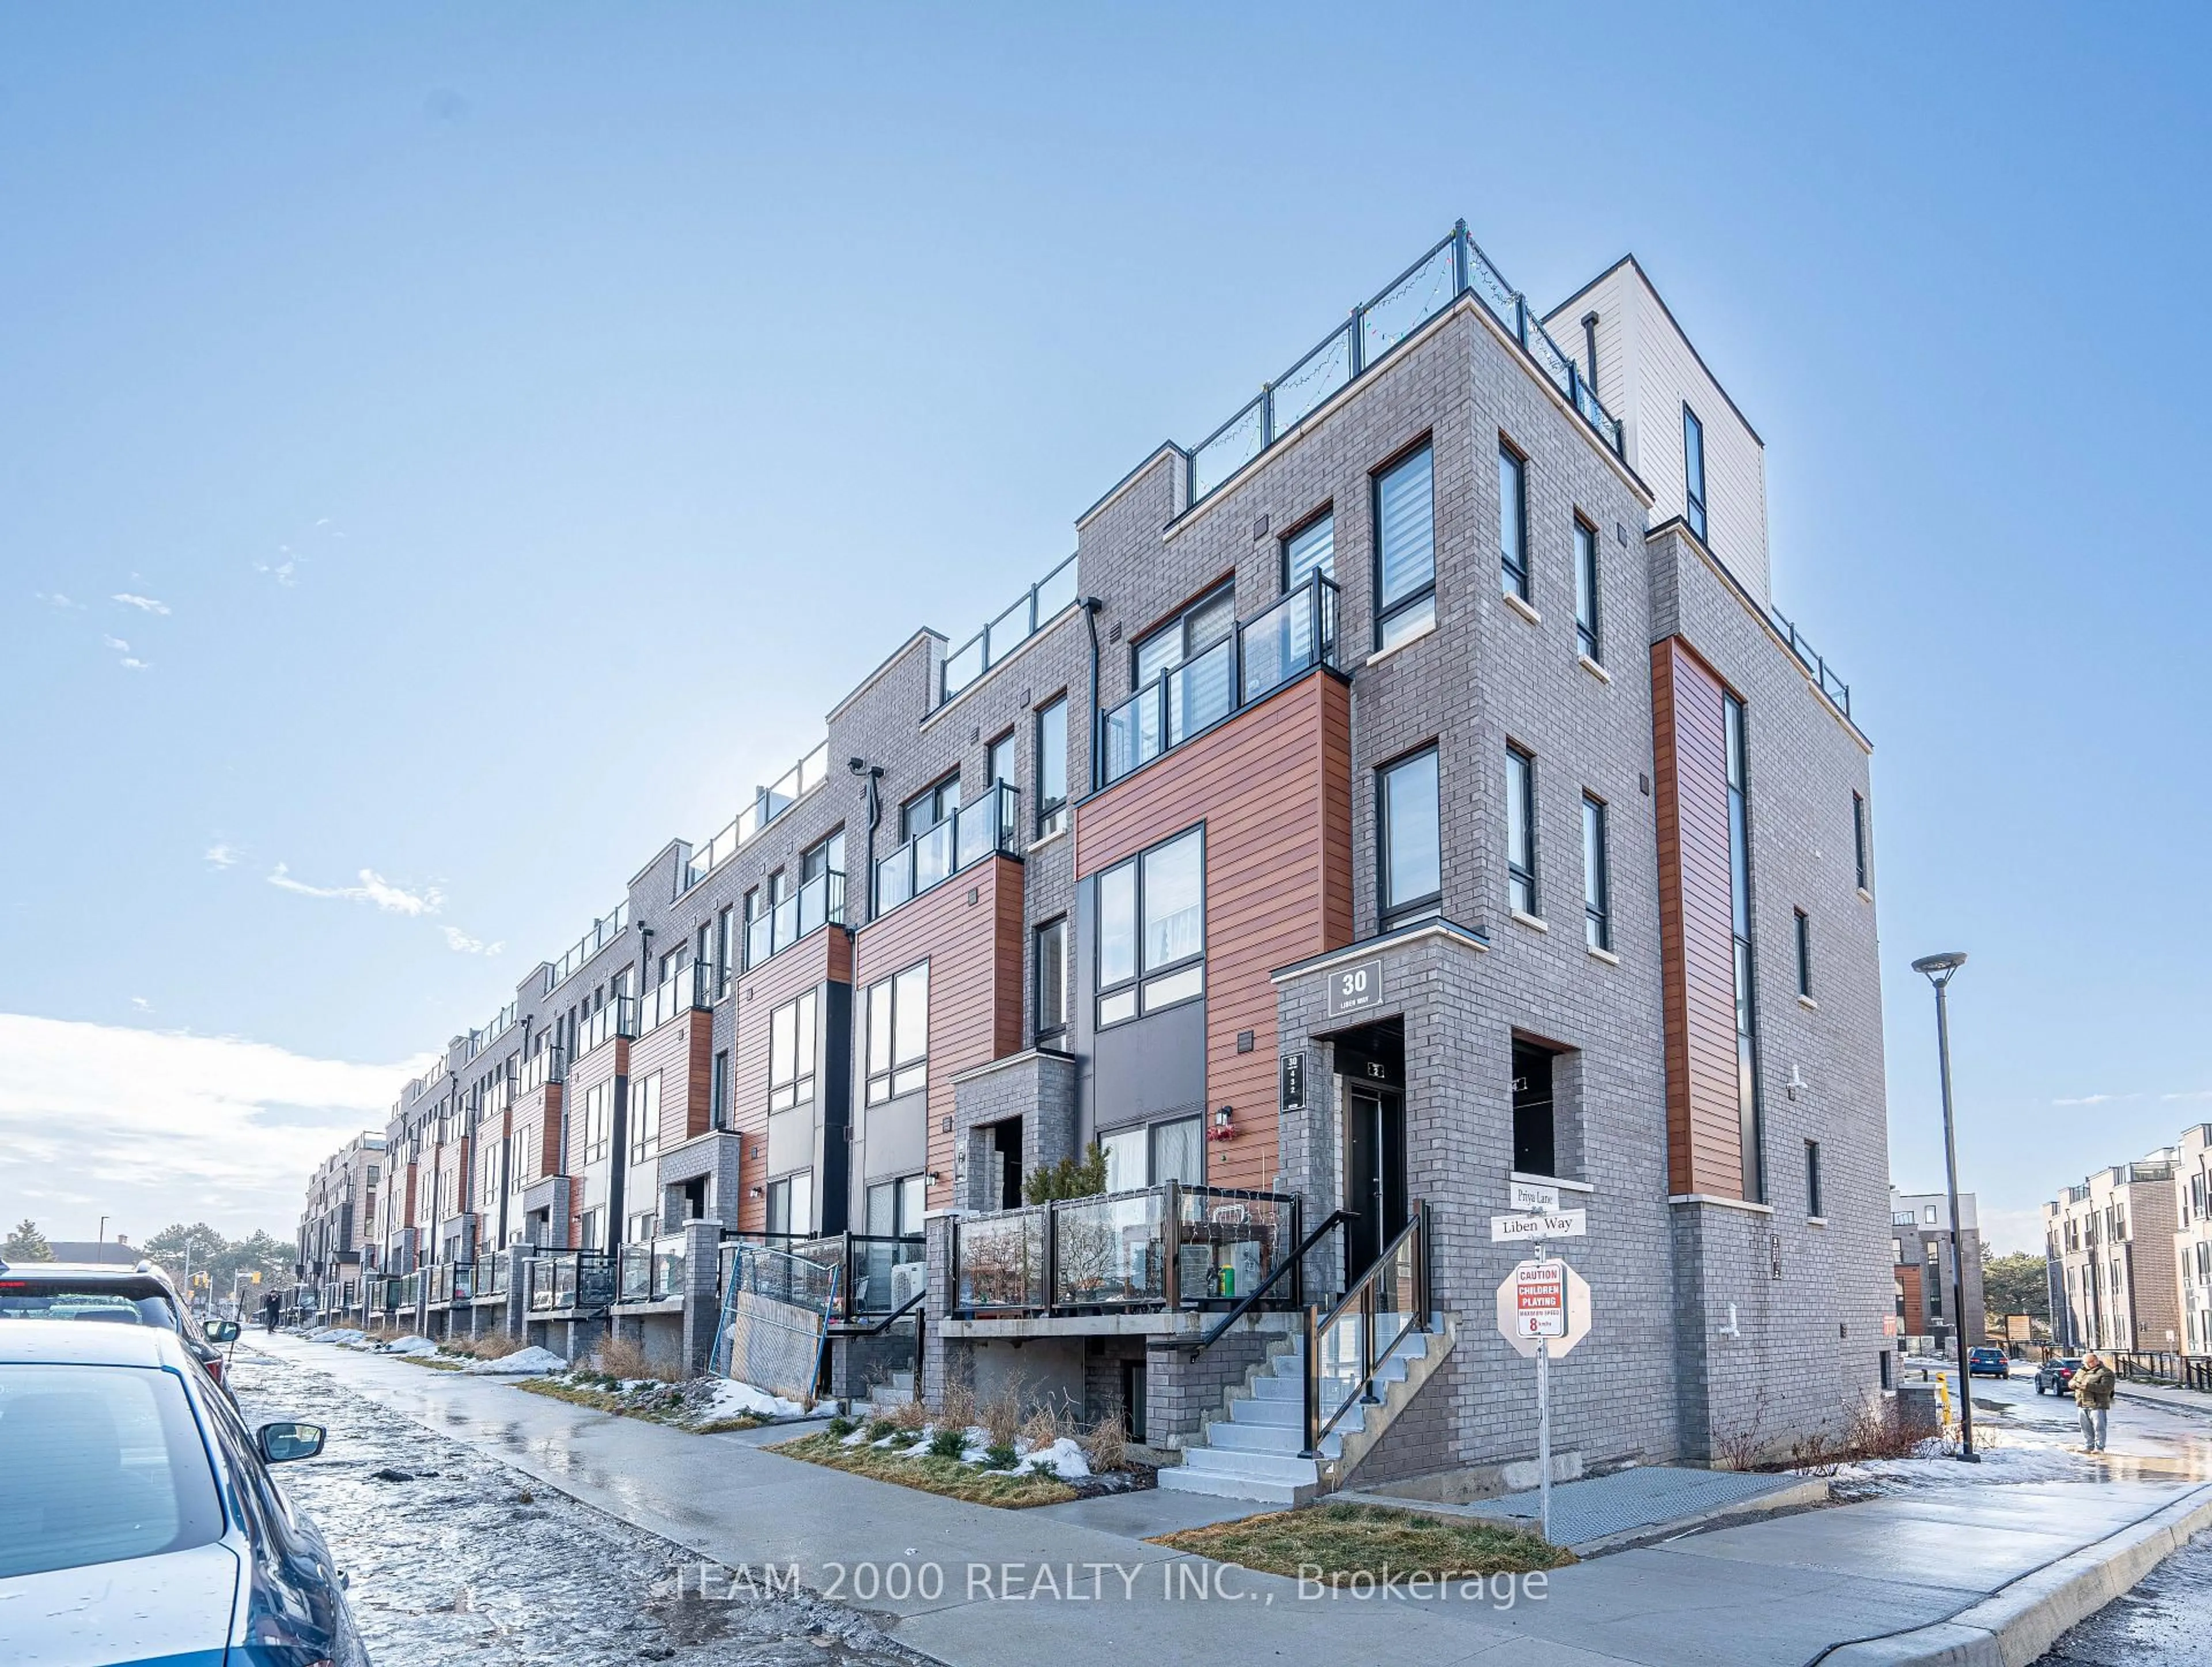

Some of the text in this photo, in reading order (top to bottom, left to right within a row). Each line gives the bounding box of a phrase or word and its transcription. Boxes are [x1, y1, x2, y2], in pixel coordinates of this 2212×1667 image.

[1343, 970, 1366, 995] 30
[1289, 1056, 1297, 1066] 30
[1518, 1189, 1553, 1205] Priya Lane
[1503, 1218, 1573, 1233] Liben Way
[1520, 1270, 1557, 1280] CAUTION
[1520, 1285, 1559, 1295] CHILDREN
[1522, 1297, 1556, 1306] PLAYING
[1530, 1318, 1537, 1331] 8
